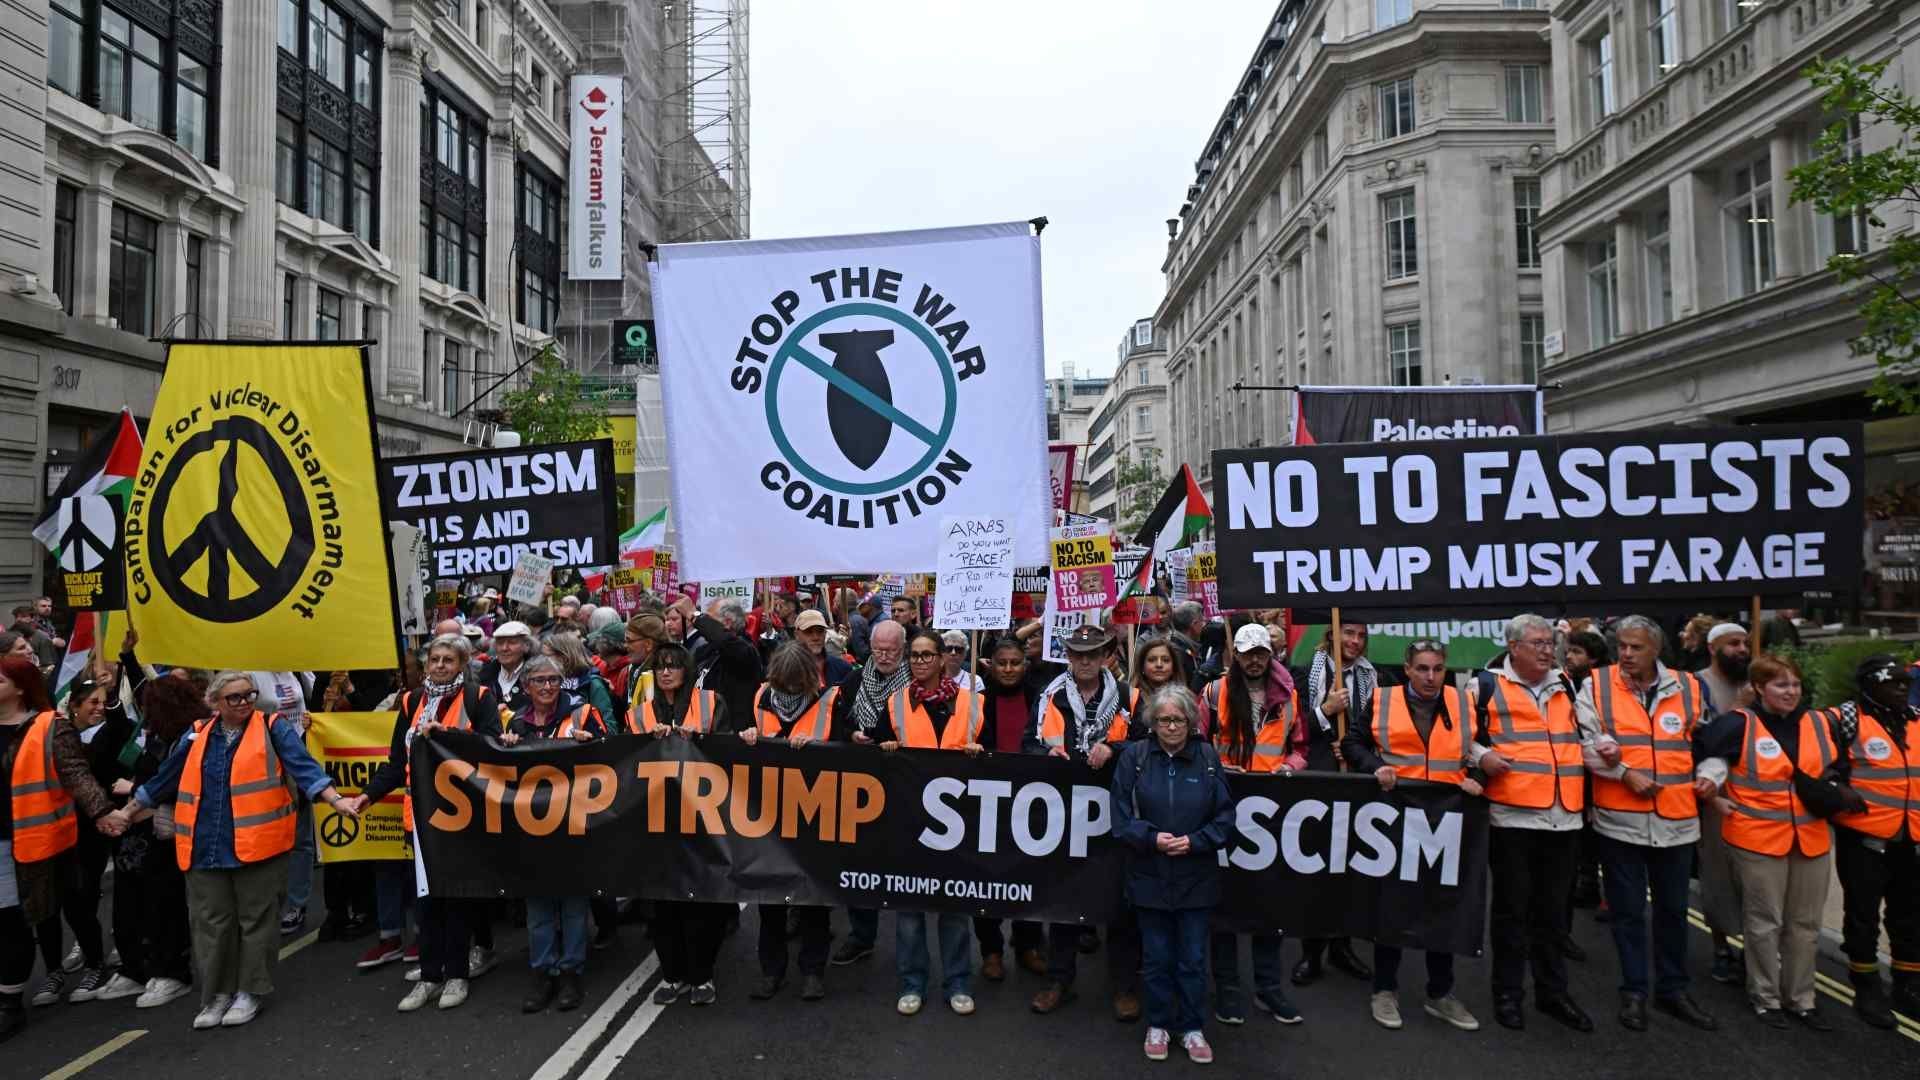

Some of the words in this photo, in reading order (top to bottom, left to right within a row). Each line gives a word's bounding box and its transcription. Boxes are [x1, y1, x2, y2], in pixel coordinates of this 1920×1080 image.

[585, 126, 607, 269] Jerramfalkus
[625, 325, 648, 347] Q
[730, 290, 800, 394] STOP
[811, 266, 903, 304] THE
[912, 283, 987, 383] WAR
[393, 447, 598, 508] ZIONISM
[1226, 459, 1320, 530] NO
[1343, 454, 1439, 526] TO
[1463, 435, 1852, 522] FASCISTS
[759, 447, 974, 530] COALITION
[125, 450, 165, 605] Campaign
[165, 406, 202, 444] for
[278, 410, 344, 620] Disarmament
[472, 509, 531, 541] AND
[949, 519, 1005, 537] ARABS
[433, 536, 595, 577] ERRORISM
[1056, 542, 1074, 555] NO
[1076, 540, 1095, 552] TO
[1057, 550, 1106, 568] RACISM
[1200, 556, 1213, 567] NO
[1252, 546, 1432, 594] TRUMP
[1447, 540, 1602, 590] MUSK
[1621, 531, 1826, 585] FARAGE
[1058, 571, 1078, 585] NO
[704, 586, 751, 598] ISRAEL
[1060, 584, 1078, 597] TO
[1204, 582, 1217, 593] NO
[1061, 592, 1108, 609] TRUMP
[1205, 593, 1218, 605] TO
[365, 814, 404, 824] Campaig
[365, 824, 379, 832] for
[379, 823, 404, 832] Nucle
[430, 759, 618, 836] STOP
[637, 760, 885, 843] TRUMP
[918, 776, 1112, 858] STOP
[1217, 795, 1464, 887] SCISM
[365, 833, 405, 842] Disarma
[839, 871, 881, 890] STOP
[884, 874, 941, 895] TRUMP
[944, 879, 1033, 902] COALITION
